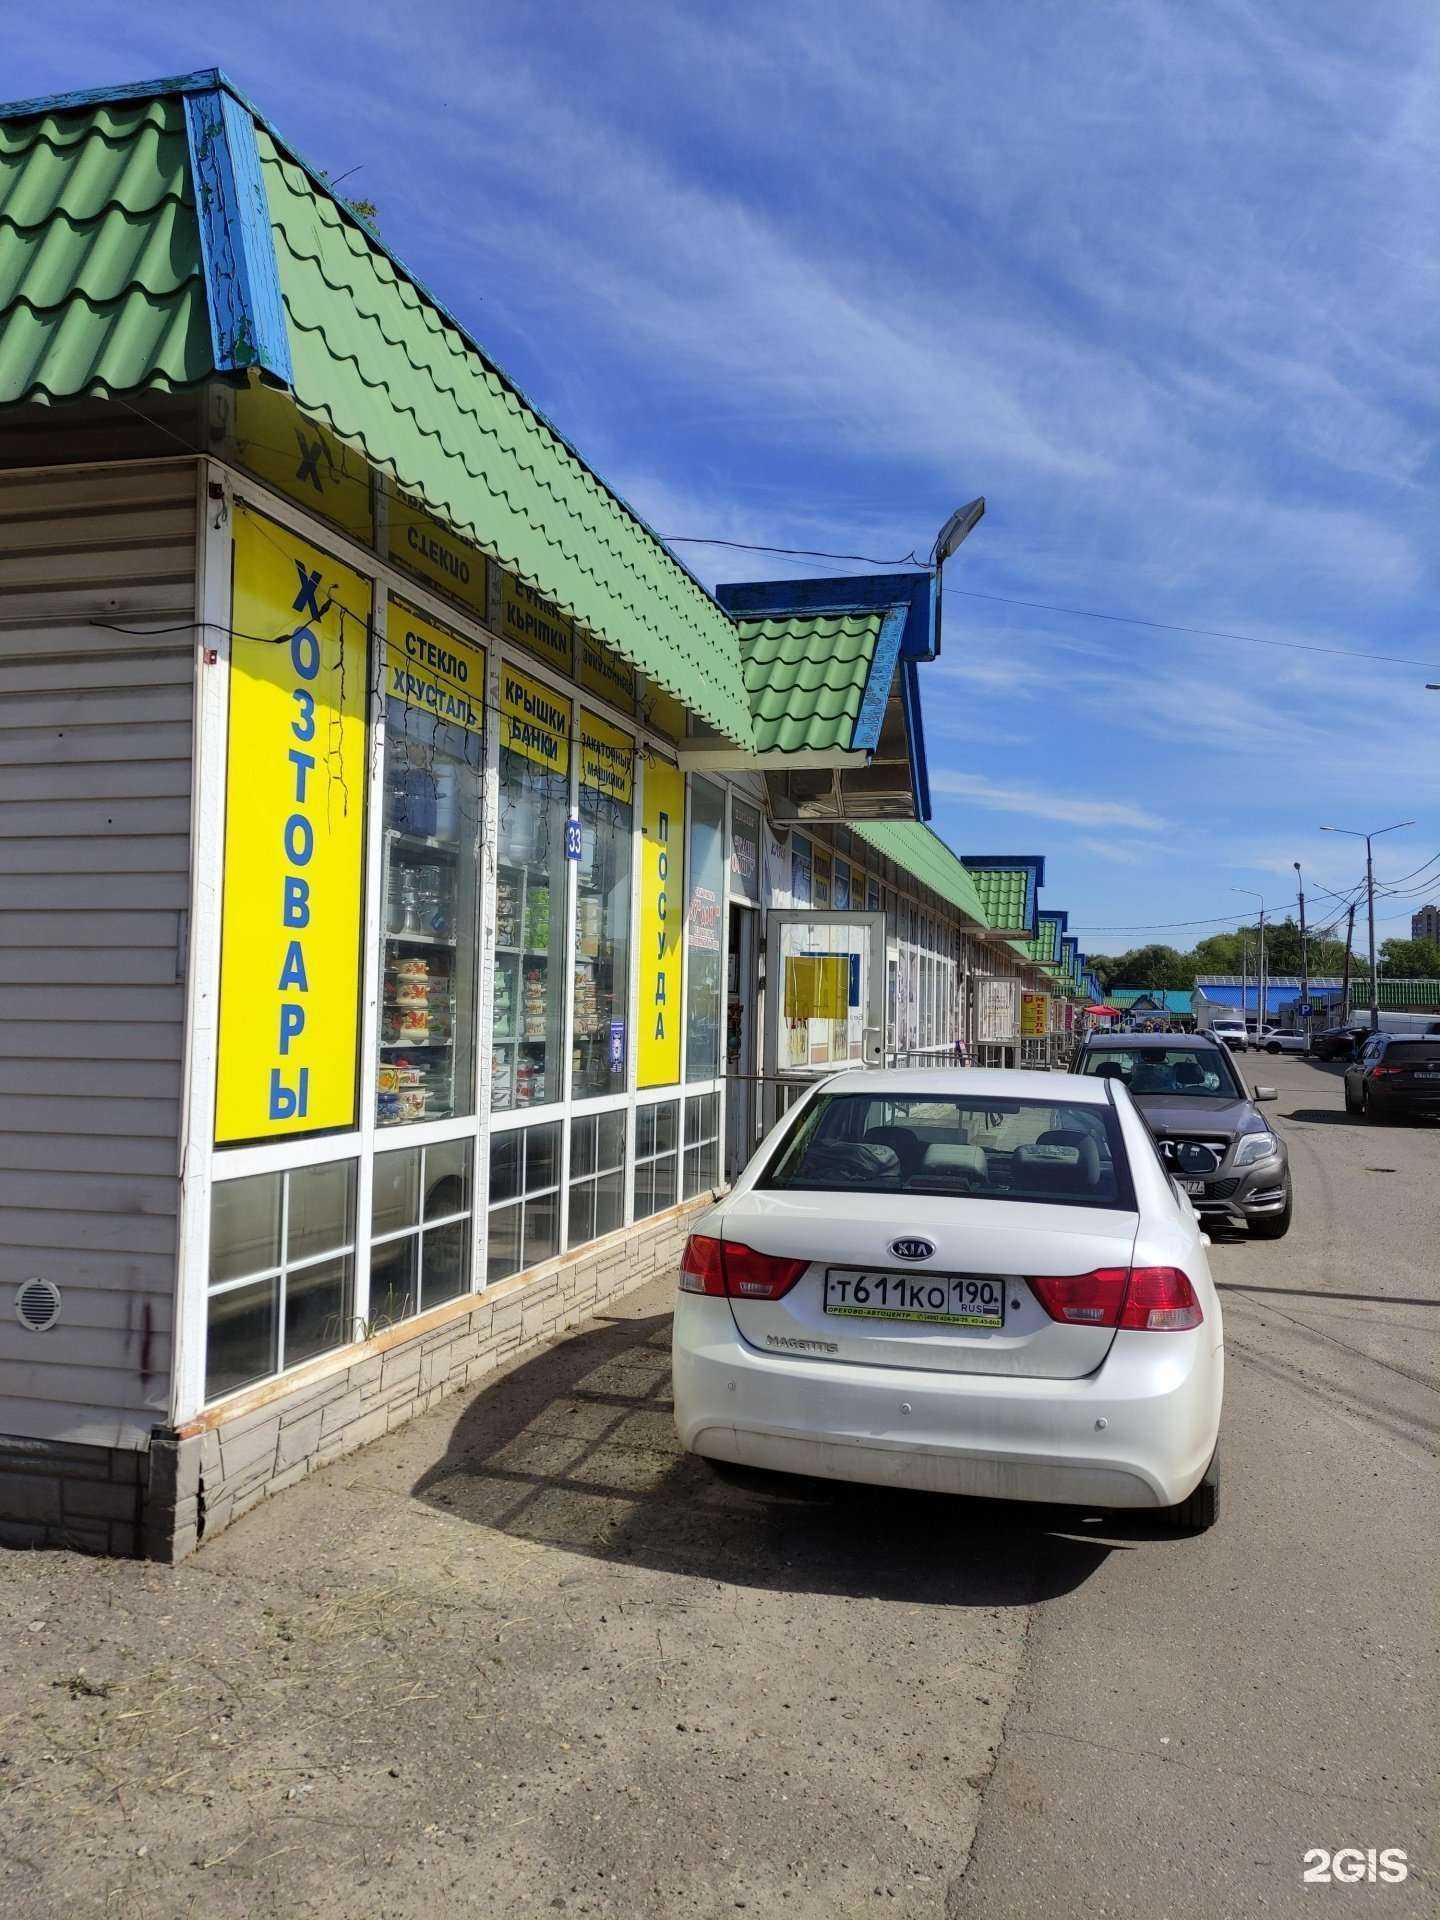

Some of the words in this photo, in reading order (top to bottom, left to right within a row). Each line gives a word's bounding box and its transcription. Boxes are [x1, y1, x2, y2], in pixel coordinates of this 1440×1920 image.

[405, 631, 468, 683] СТЕКЛО
[393, 667, 478, 726] ХРУСТАЛЬ
[505, 678, 566, 734] КРЫШКИ
[512, 716, 558, 761] БАНКИ
[269, 559, 323, 1120] ХОЗТОВАРЫ
[569, 827, 581, 854] 33
[654, 811, 669, 1041] ПОСУДА
[1301, 1005, 1311, 1016] P
[897, 1242, 929, 1256] KIA
[952, 1281, 995, 1304] 190
[961, 1303, 983, 1314] RUS
